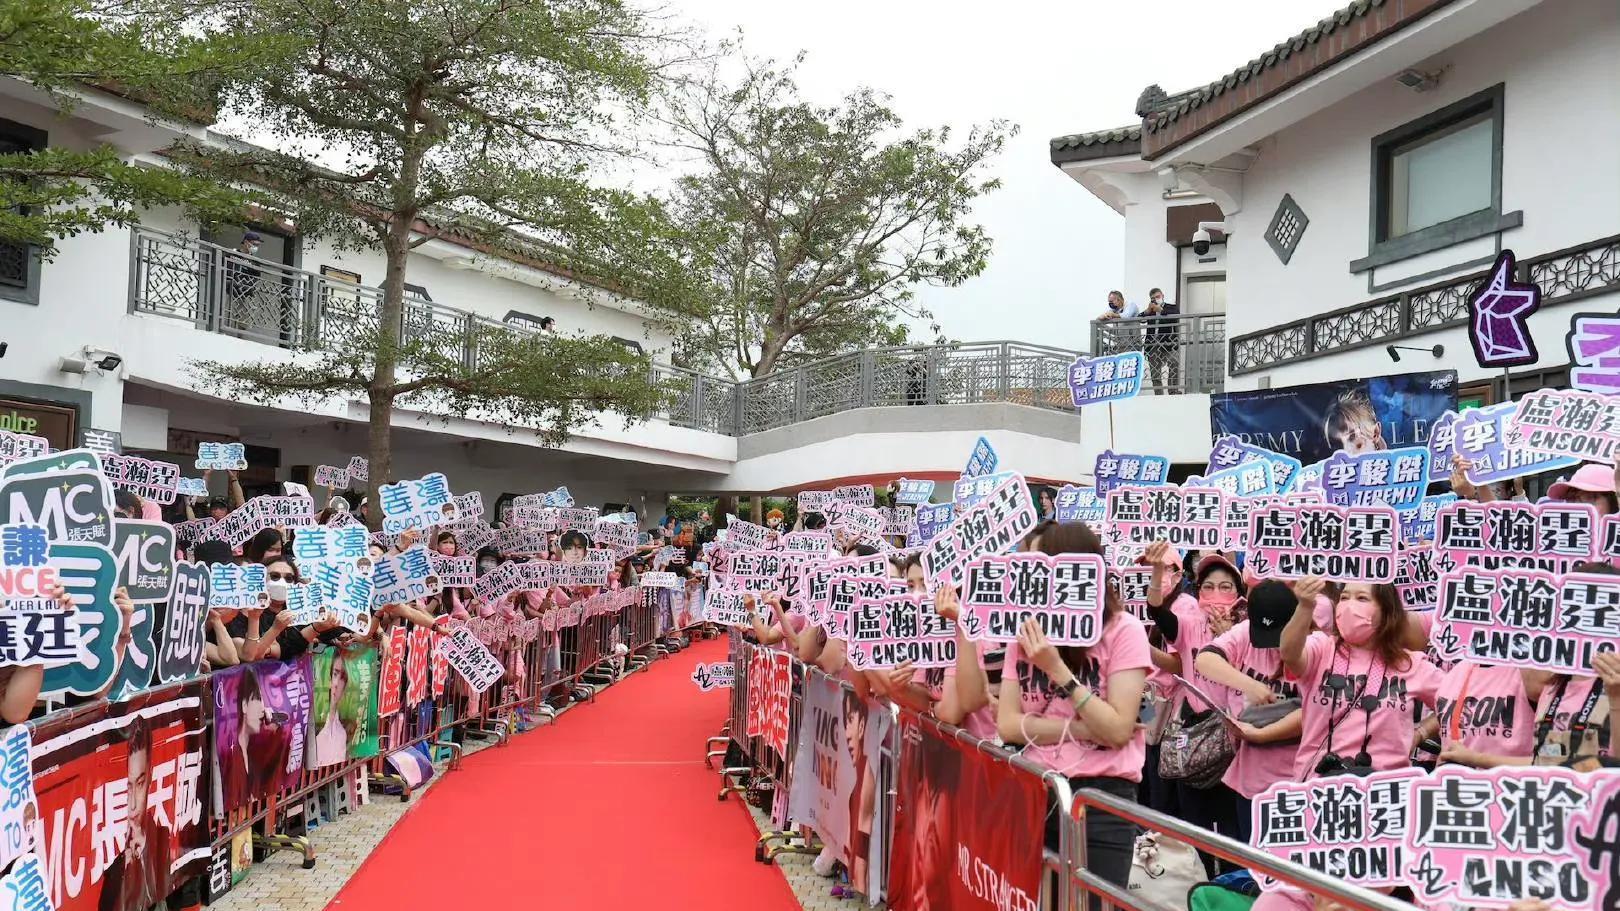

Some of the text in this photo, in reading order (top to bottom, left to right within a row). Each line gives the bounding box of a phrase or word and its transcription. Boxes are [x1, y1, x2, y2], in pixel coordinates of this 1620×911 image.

[1072, 357, 1138, 385] 李駿傑
[1089, 380, 1135, 400] JEREMY
[1529, 430, 1603, 457] ANSON
[1097, 457, 1164, 482] 李駿傑
[1328, 455, 1424, 491] 李駿傑
[1111, 490, 1221, 523] 盧瀚霆
[1353, 487, 1417, 508] JEREMY
[918, 508, 951, 525] 李駿
[926, 482, 1021, 578] 盧瀚霆
[1012, 510, 1032, 536] LO
[1255, 507, 1395, 553] 盧瀚霆
[2, 525, 48, 567] 謙
[68, 525, 106, 542] 張天賦
[1130, 525, 1219, 546] ANSON LO
[1440, 508, 1592, 556] 盧瀚霆
[1278, 554, 1362, 579] ANSON
[1365, 555, 1389, 579] LO
[138, 576, 168, 589] 張天賦
[968, 560, 1098, 608] 盧瀚霆
[11, 600, 34, 611] JER
[1442, 574, 1620, 637] 盧瀚霆
[853, 600, 956, 641] 盧瀚霆
[1070, 613, 1094, 639] LO
[872, 640, 956, 665] ANSON LO
[1470, 630, 1577, 667] ANSON
[1578, 692, 1598, 723] SONY
[1415, 778, 1590, 852] 盧瀚
[957, 842, 973, 897] MR.
[1463, 857, 1592, 902] ANSO
